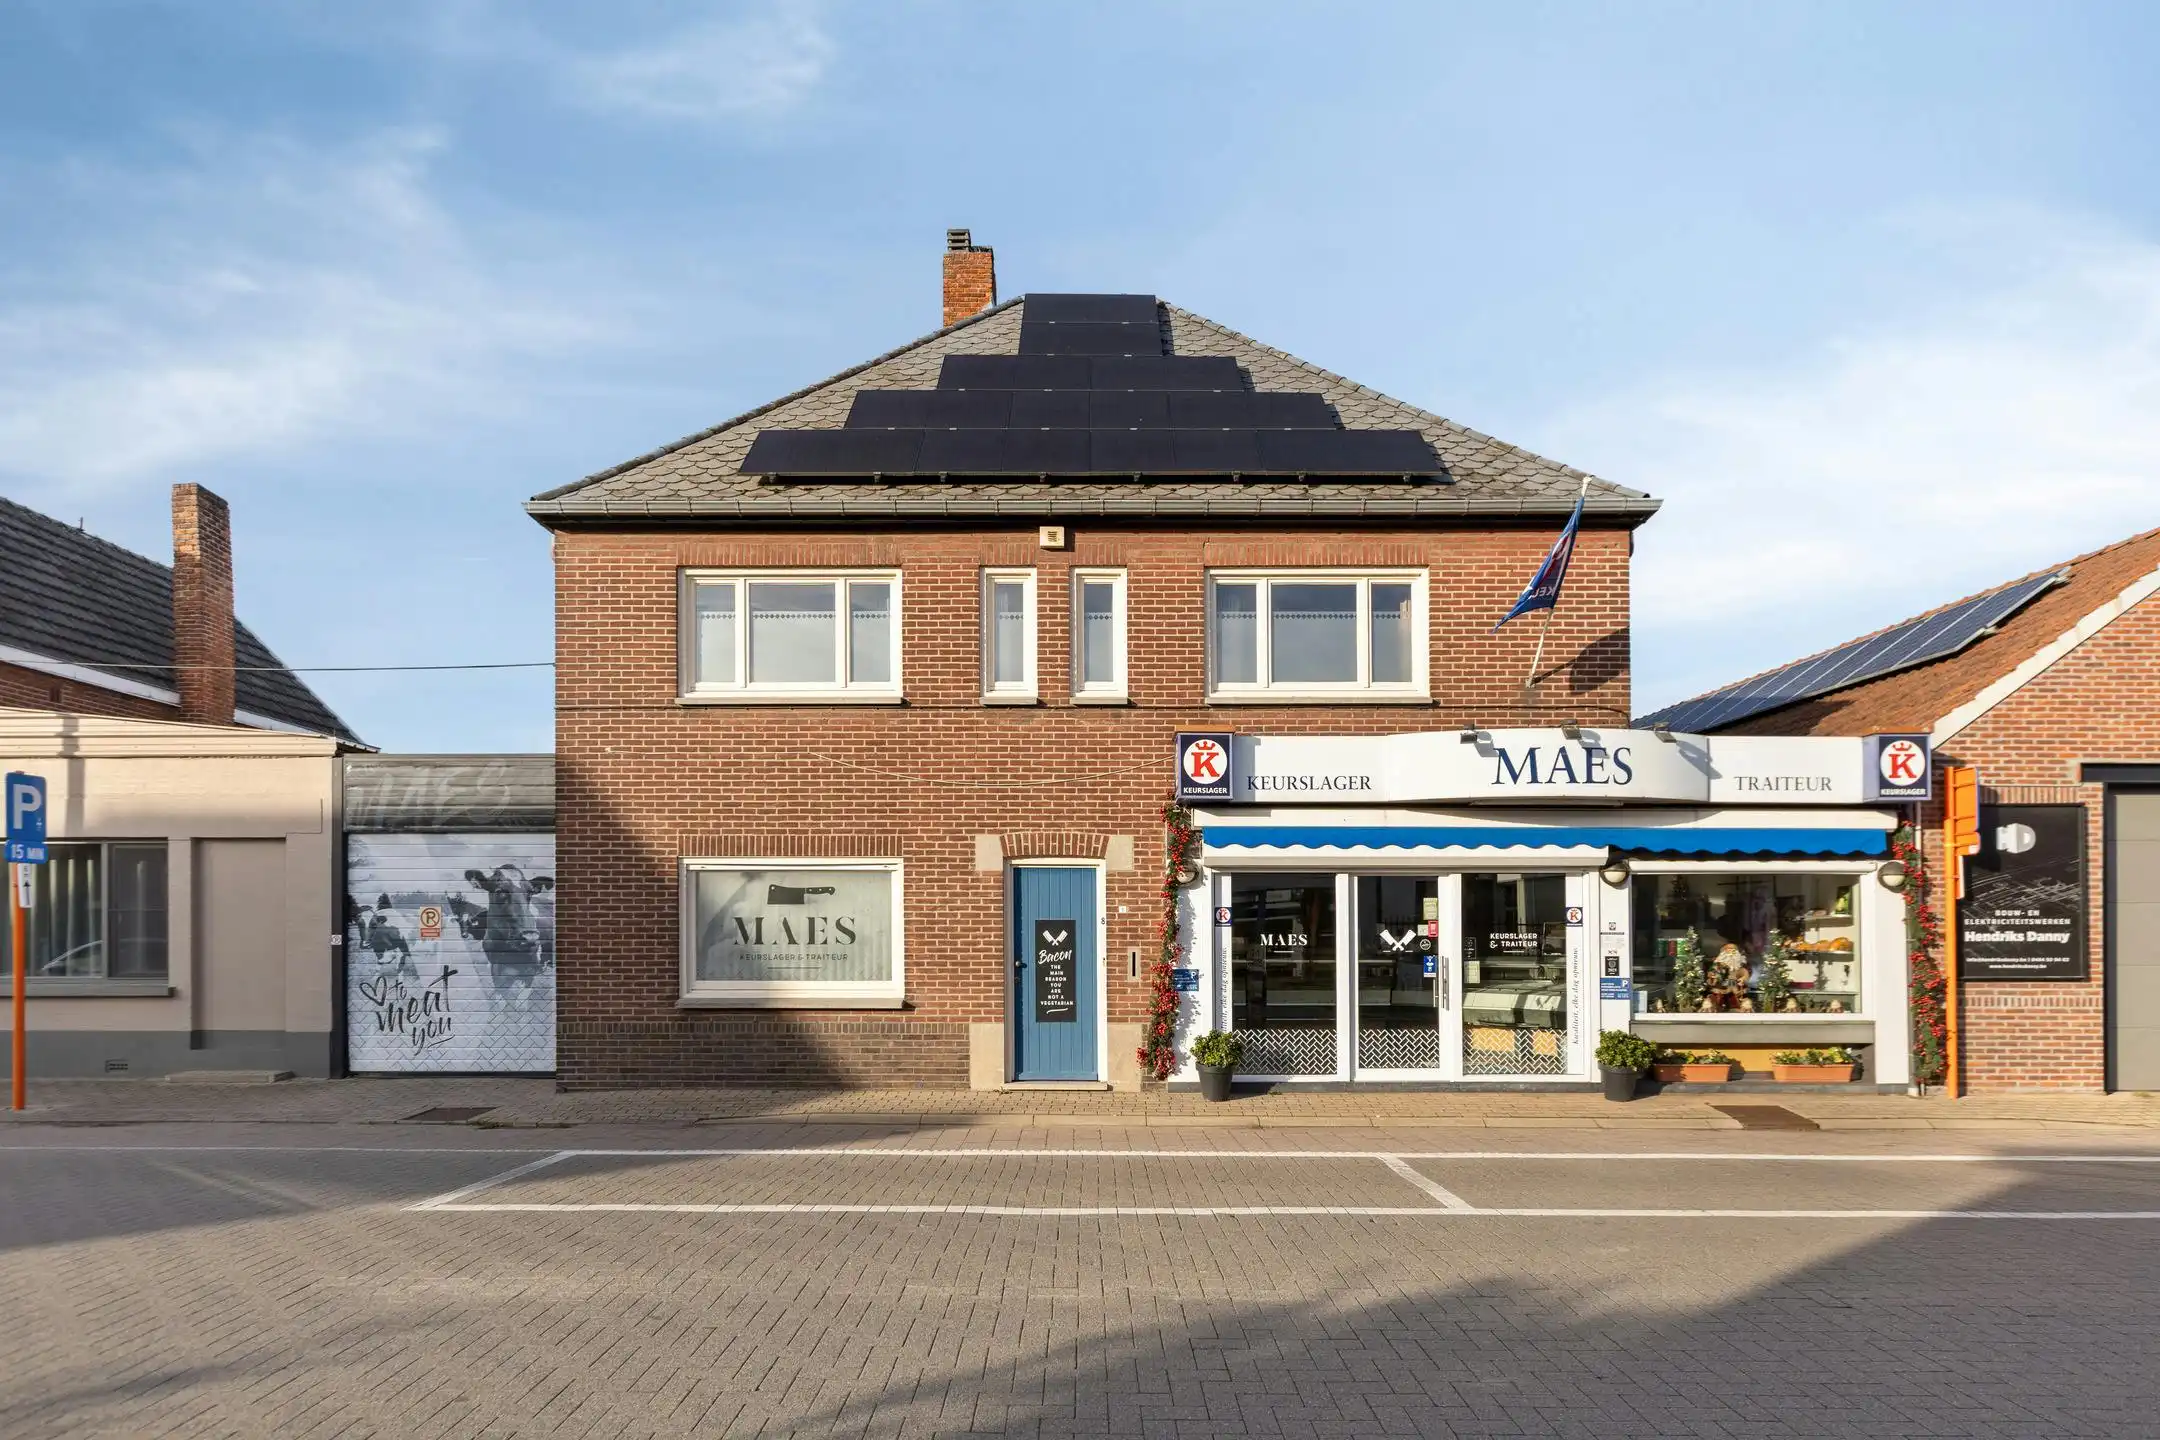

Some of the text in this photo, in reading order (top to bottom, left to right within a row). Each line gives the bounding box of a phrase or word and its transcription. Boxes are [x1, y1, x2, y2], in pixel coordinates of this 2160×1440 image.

[1191, 752, 1220, 777] K
[1491, 746, 1633, 785] MAES
[1888, 753, 1917, 779] K
[1183, 786, 1228, 794] KEURSLAGER
[1247, 776, 1371, 791] KEURSLAGER
[1735, 776, 1832, 792] TRAITEUR
[1881, 788, 1926, 796] KEURSLAGER
[13, 784, 41, 829] P
[11, 844, 24, 859] 15
[733, 916, 857, 945] MAES
[1964, 931, 2070, 943] Hendriks Danny
[1260, 933, 1308, 946] MAES
[1490, 940, 1498, 949] &
[739, 953, 795, 961] KEURSLAGER
[806, 953, 849, 961] TRAITEUR
[1038, 949, 1072, 964] Bacon
[388, 980, 408, 1002] to
[1622, 980, 1628, 988] P
[375, 965, 458, 1034] meat
[412, 1016, 452, 1057] you
